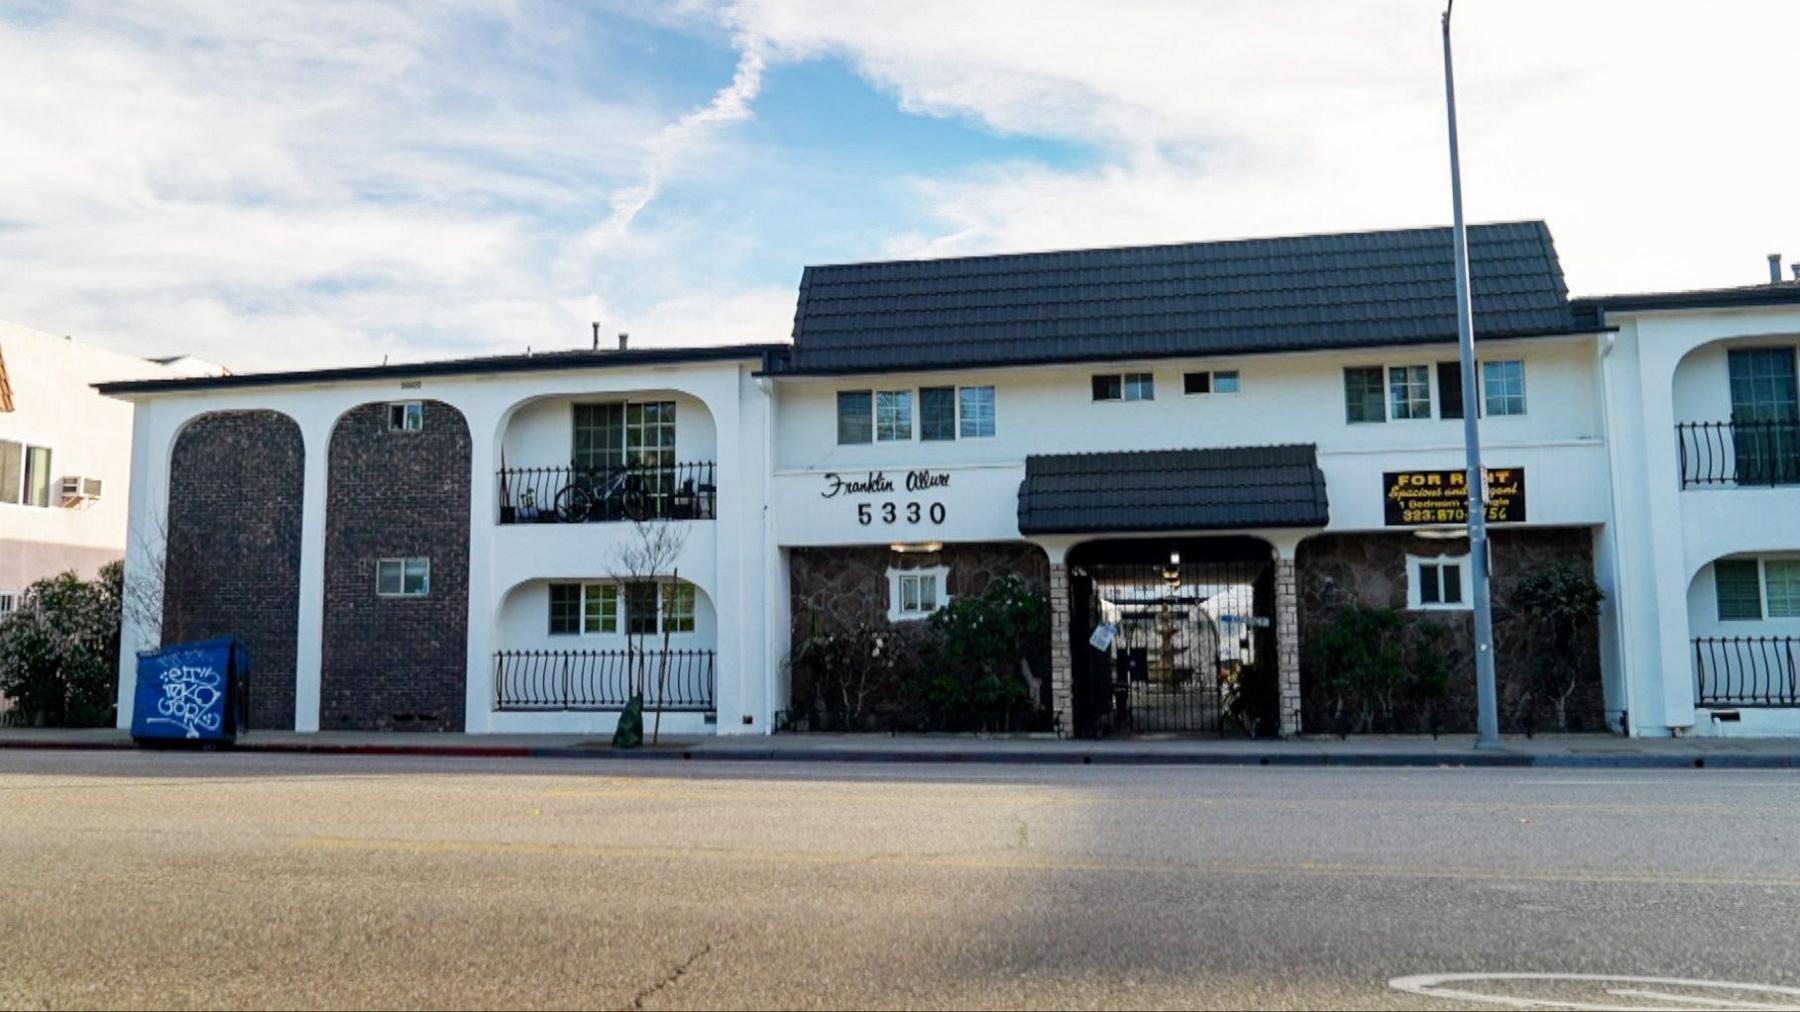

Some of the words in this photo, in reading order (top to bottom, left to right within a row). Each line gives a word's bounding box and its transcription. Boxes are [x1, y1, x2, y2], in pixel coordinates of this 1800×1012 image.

[820, 472, 895, 498] Franklin
[906, 469, 951, 492] Allure
[1398, 473, 1442, 486] FOR
[1450, 471, 1510, 486] RT
[1388, 485, 1442, 501] Spacious
[1408, 499, 1460, 509] Bedroom
[858, 502, 946, 526] 5330
